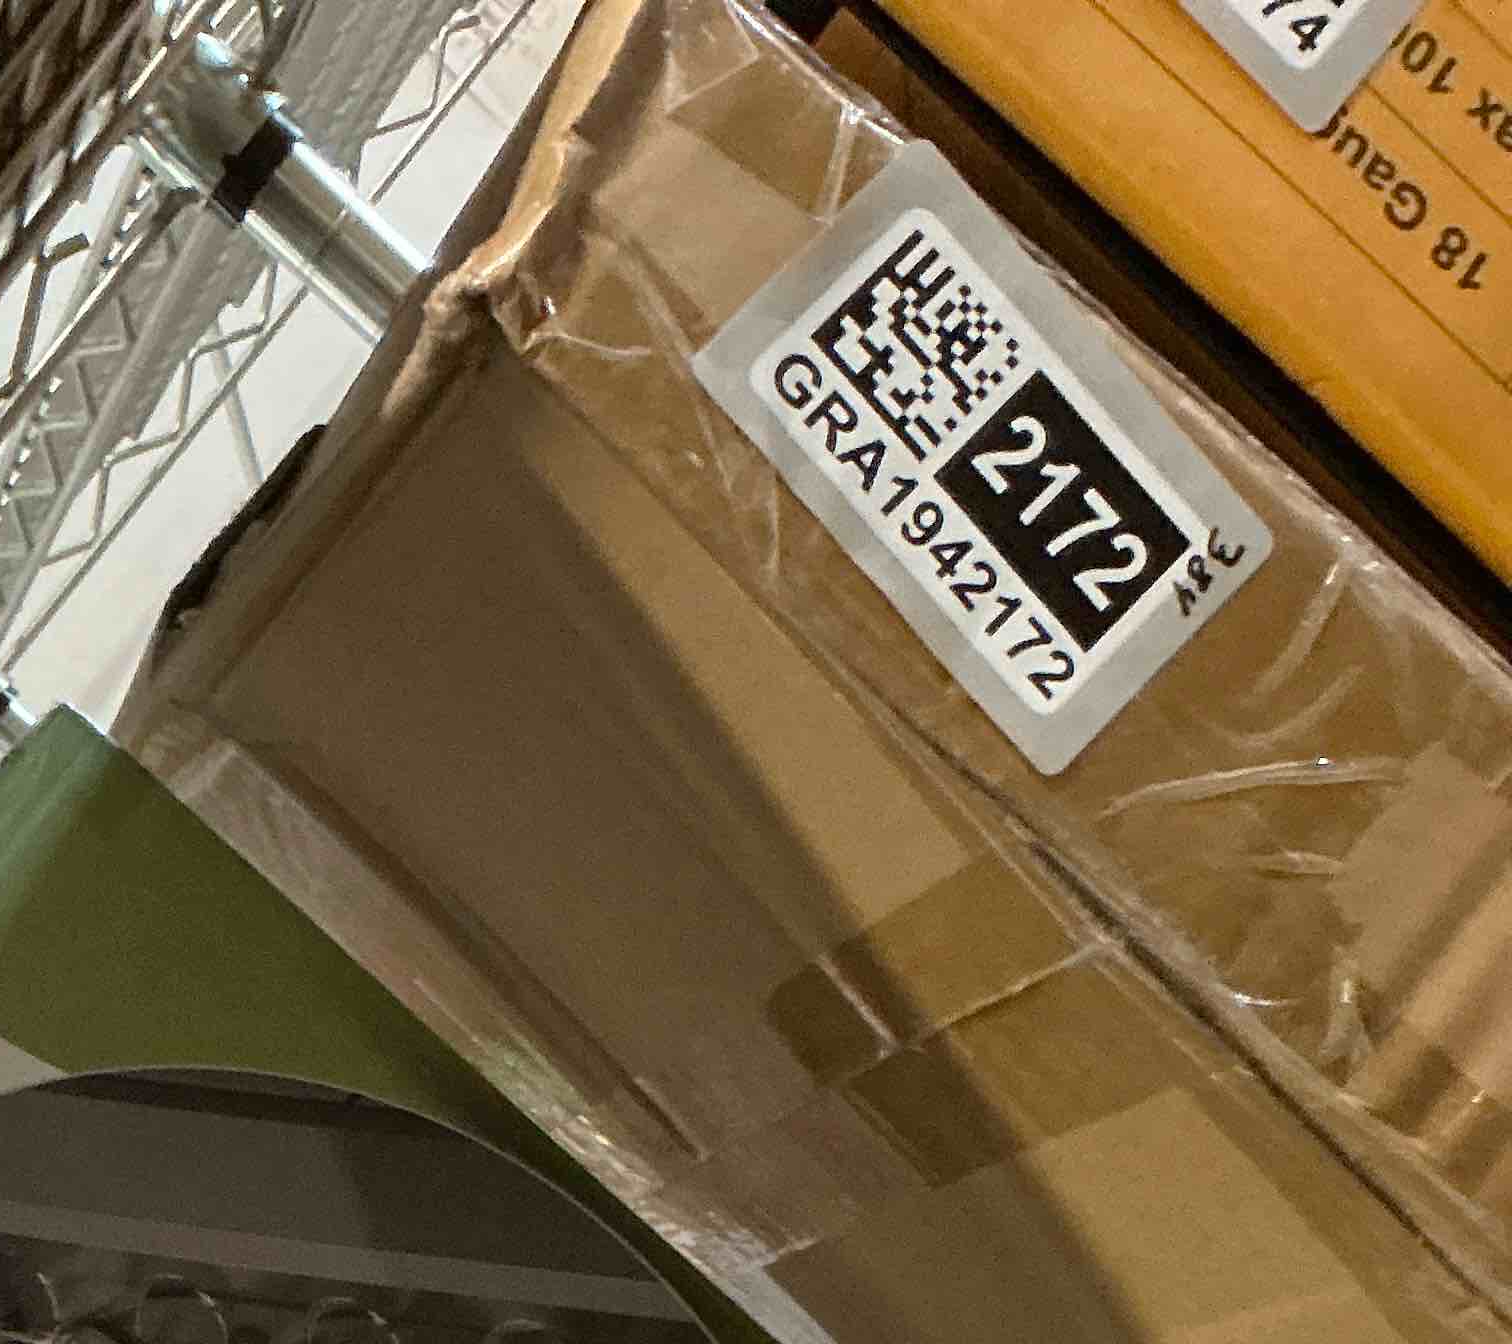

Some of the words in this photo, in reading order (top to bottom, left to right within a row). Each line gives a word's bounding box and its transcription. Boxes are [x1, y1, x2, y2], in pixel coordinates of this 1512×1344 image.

[1430, 226, 1488, 291] 18
[772, 353, 1076, 701] GRA1942172
[962, 415, 1148, 612] 2172
